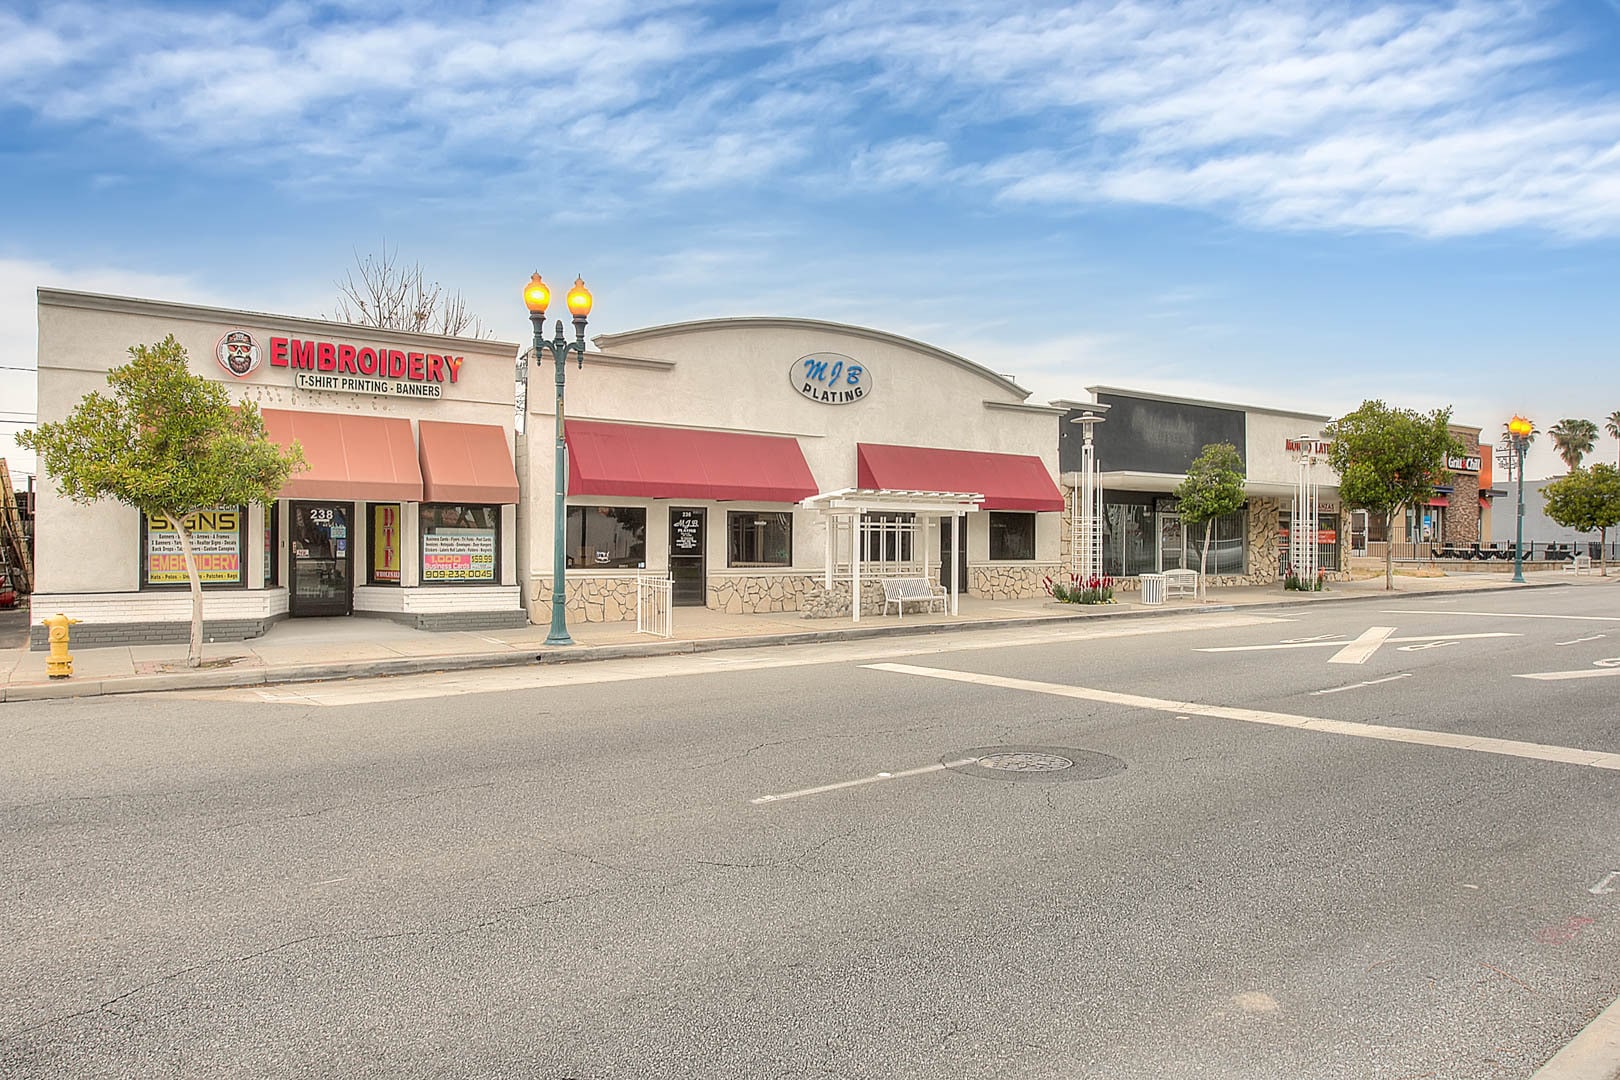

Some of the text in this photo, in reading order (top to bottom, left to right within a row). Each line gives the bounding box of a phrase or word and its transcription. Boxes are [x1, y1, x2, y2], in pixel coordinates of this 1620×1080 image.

[270, 337, 463, 383] EMBROIDERY
[300, 375, 339, 389] T-SHIRT
[342, 379, 388, 393] PRINTING
[397, 384, 440, 397] BANNERS
[802, 382, 863, 402] PLATING
[1286, 439, 1312, 453] MUNO
[310, 509, 334, 519] 238
